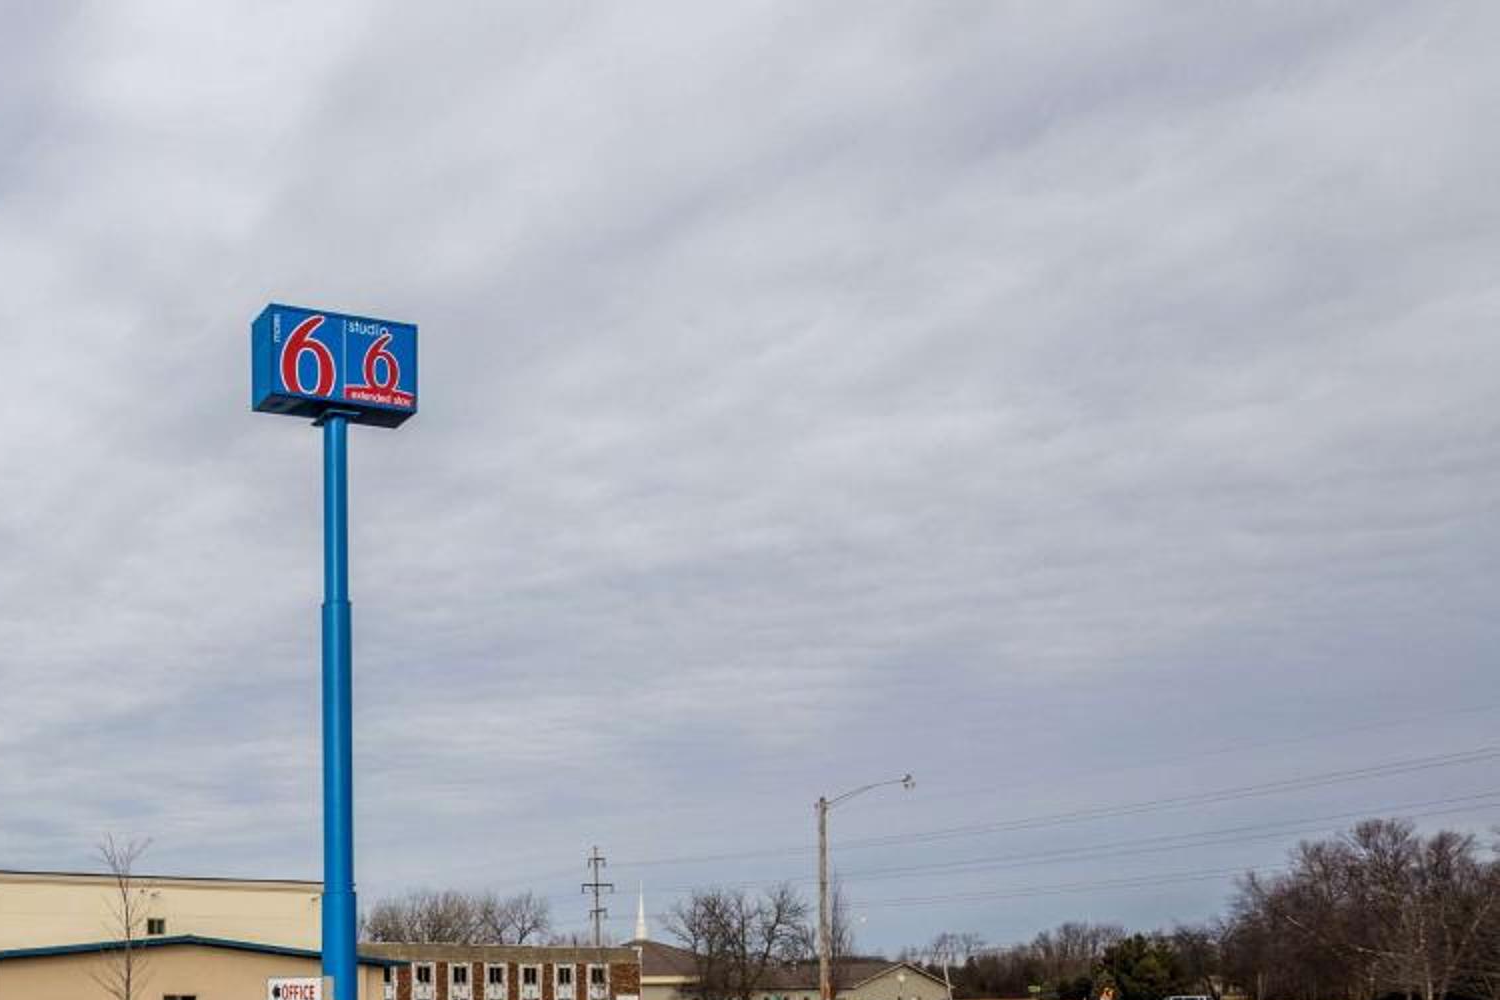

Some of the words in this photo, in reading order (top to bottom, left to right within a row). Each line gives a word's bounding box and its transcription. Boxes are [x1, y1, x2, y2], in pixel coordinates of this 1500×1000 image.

[348, 321, 388, 336] studio
[280, 315, 336, 397] 6
[363, 333, 400, 390] 6
[282, 984, 315, 1000] OFFICE
